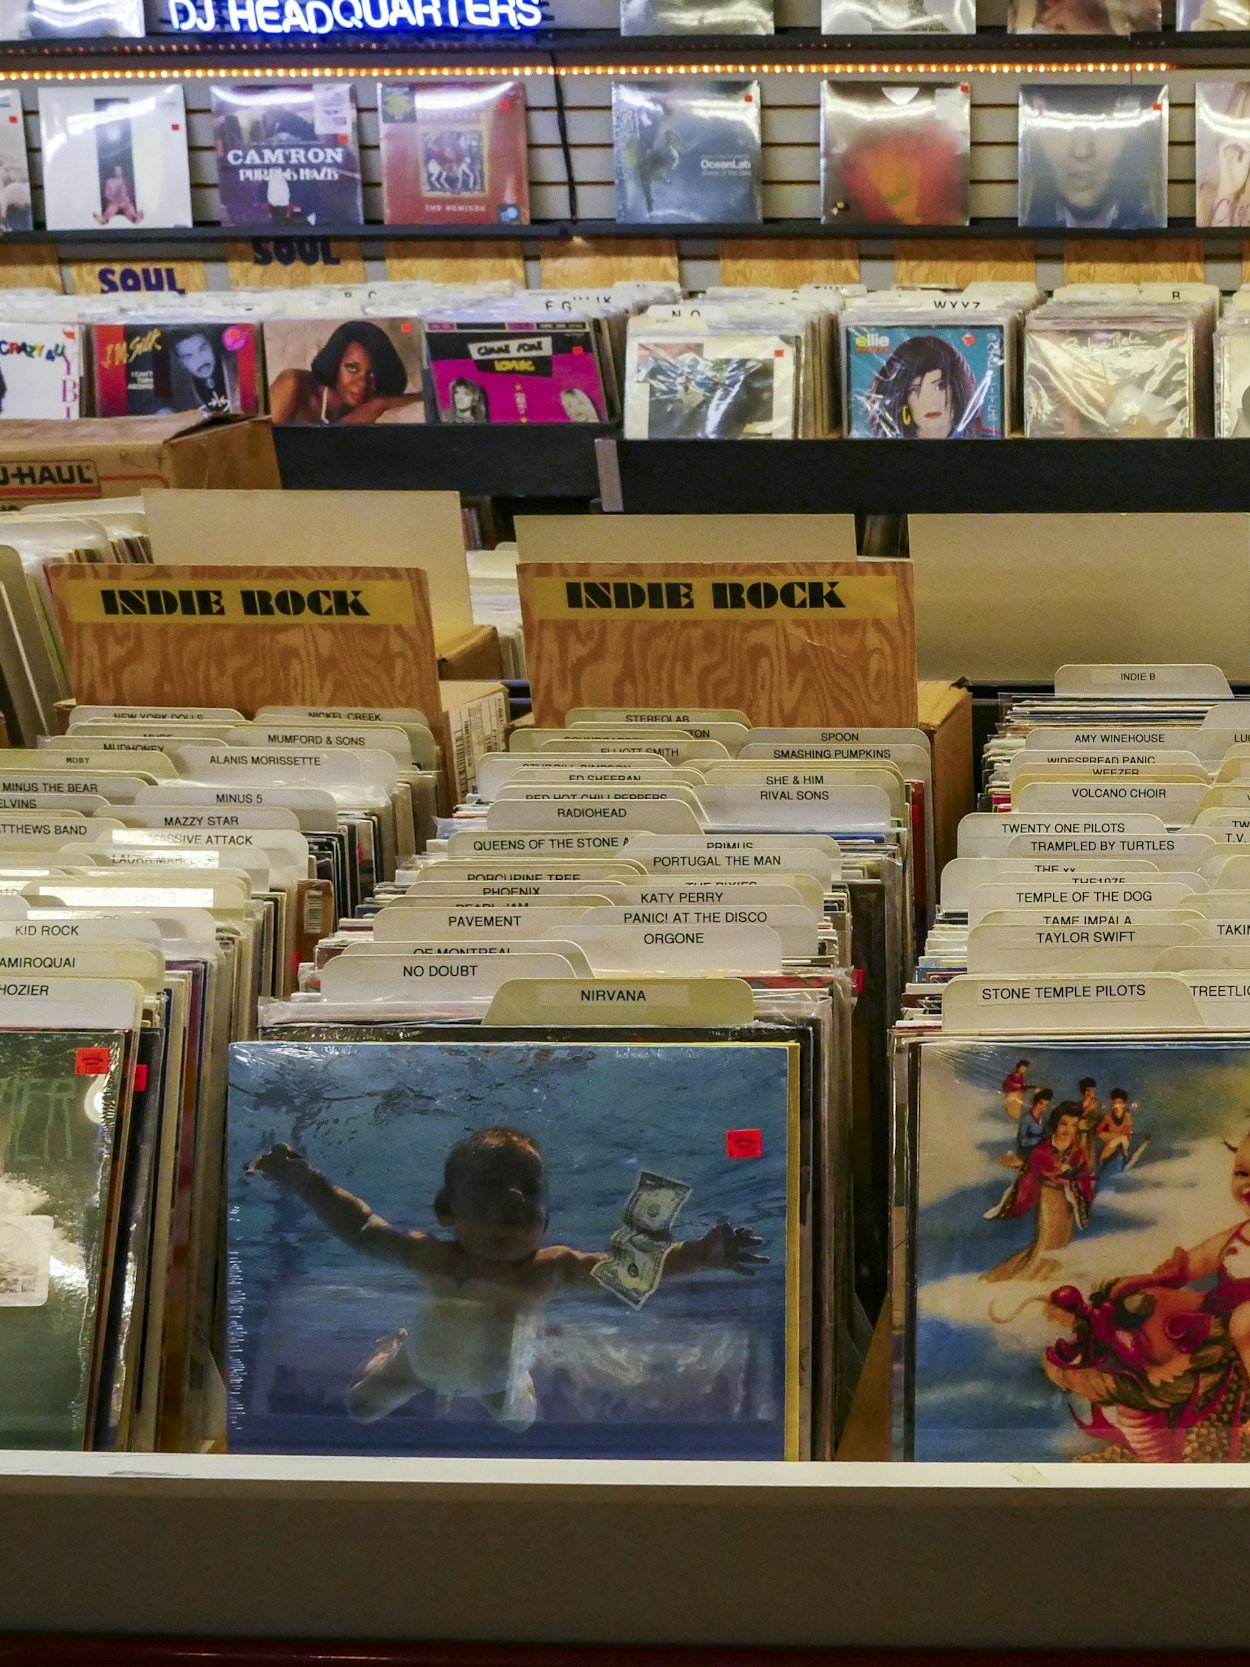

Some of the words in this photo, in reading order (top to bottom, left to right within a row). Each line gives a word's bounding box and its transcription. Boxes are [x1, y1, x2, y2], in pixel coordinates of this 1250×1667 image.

[168, 0, 217, 31] DJ
[230, 0, 542, 35] HEADQUARTERS
[227, 147, 344, 165] CAM'RON
[252, 237, 341, 266] SOUL
[98, 267, 187, 294] SOUL
[566, 582, 694, 609] INDIE
[712, 581, 846, 609] ROCK
[101, 590, 226, 616] INDIE
[241, 590, 370, 616] ROCK
[1120, 673, 1147, 681] INDIE
[1149, 673, 1156, 681] B
[268, 734, 323, 744] MUMFORD
[325, 736, 333, 744] &
[335, 736, 366, 746] SONS
[821, 732, 860, 742] SPOON
[1074, 734, 1097, 743] AMY
[1099, 734, 1166, 743] WINEHOUSE
[646, 748, 679, 757] SMITH
[773, 749, 832, 759] SMASHING
[834, 749, 891, 759] PUMPKINS
[210, 755, 248, 765] ALANIS
[251, 756, 321, 766] MORISSETTE
[765, 776, 790, 785] SHE
[792, 776, 800, 785] &
[803, 775, 824, 784] HIM
[2, 782, 39, 792] MINUS
[42, 783, 64, 792] THE
[67, 783, 98, 793] BEAR
[1072, 788, 1127, 798] VOLCANO
[1130, 788, 1166, 798] CHOIR
[216, 793, 253, 803] MINUS
[256, 793, 263, 803] 5
[760, 790, 793, 800] RIVAL
[796, 790, 829, 800] SONS
[557, 808, 627, 818] RADIOHEAD
[164, 816, 204, 826] MAZZY
[207, 816, 239, 826] STAR
[54, 825, 88, 835] BAND
[1001, 823, 1051, 834] TWENTY
[1054, 823, 1080, 833] ONE
[1083, 823, 1125, 833] PILOTS
[205, 835, 253, 845] ATTACK
[1225, 833, 1247, 843] T.V.
[473, 839, 525, 851] QUEENS
[528, 839, 546, 849] OF
[549, 838, 573, 849] THE
[576, 837, 614, 848] STONE
[1031, 841, 1097, 851] TRAMPLED
[1100, 841, 1116, 851] BY
[1119, 841, 1175, 851] TURTLES
[653, 856, 721, 866] PORTUGAL
[725, 856, 749, 866] THE
[753, 856, 781, 865] MAN
[640, 892, 675, 903] KATY
[678, 892, 724, 903] PERRY
[1016, 892, 1068, 903] TEMPLE
[1071, 891, 1089, 902] OF
[1094, 891, 1119, 902] THE
[1123, 891, 1152, 902] DOG
[448, 916, 521, 927] PAVEMENT
[624, 912, 669, 923] PANIC!
[672, 912, 690, 923] AT
[694, 912, 721, 923] THE
[725, 911, 768, 923] DISCO
[1043, 916, 1079, 924] TAME
[1084, 916, 1132, 924] IMPALA
[15, 925, 37, 936] KID
[41, 925, 79, 936] ROCK
[643, 933, 704, 944] ORGONE
[1036, 932, 1089, 943] TAYLOR
[1093, 931, 1136, 942] SWIFT
[403, 965, 424, 977] NO
[429, 965, 478, 977] DOUBT
[581, 990, 646, 1001] NIRVANA
[982, 987, 1031, 1000] STONE
[1035, 986, 1091, 998] TEMPLE
[1095, 984, 1146, 997] PILOTS
